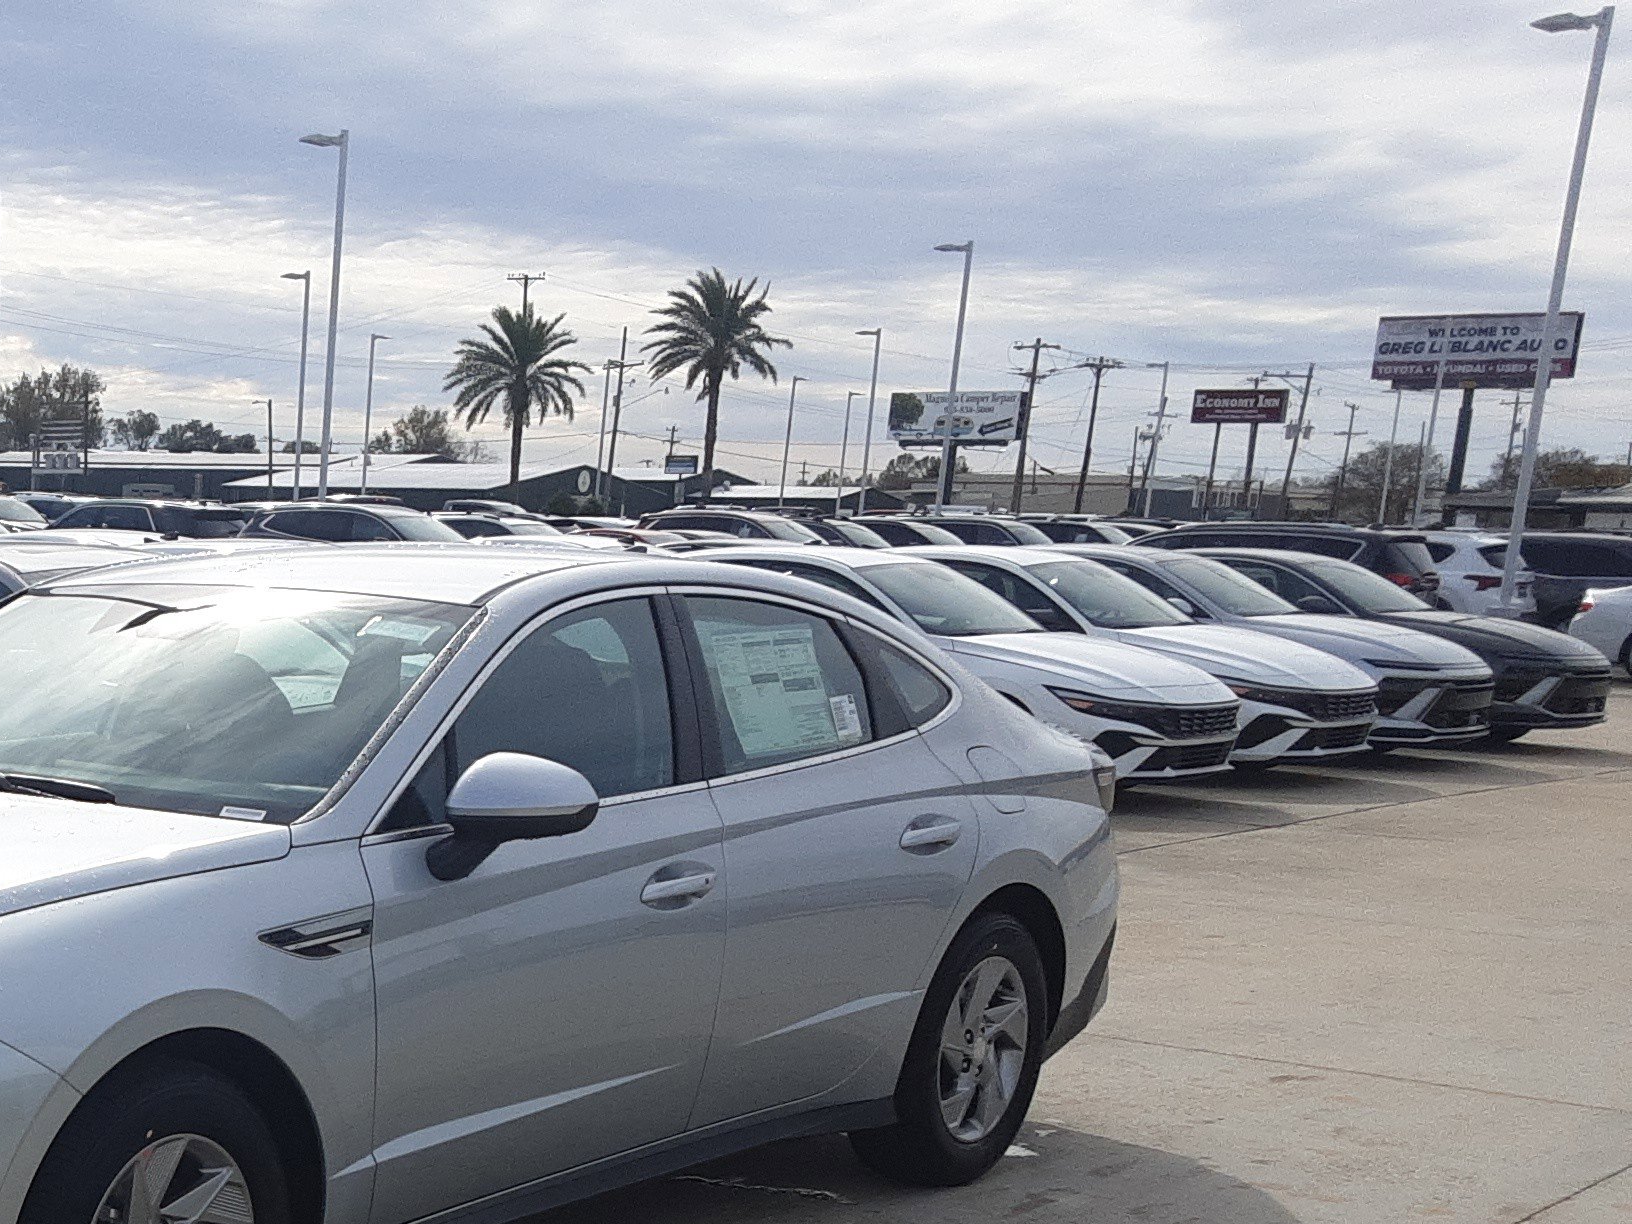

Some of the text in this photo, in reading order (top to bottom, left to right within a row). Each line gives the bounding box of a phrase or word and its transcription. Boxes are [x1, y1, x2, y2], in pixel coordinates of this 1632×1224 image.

[1501, 326, 1520, 336] TO
[1378, 341, 1426, 355] GREG
[1514, 338, 1568, 352] AUO
[1376, 365, 1424, 375] TOYOTA
[1496, 363, 1528, 373] USED
[961, 393, 989, 405] Camper
[991, 394, 1018, 405] Repair
